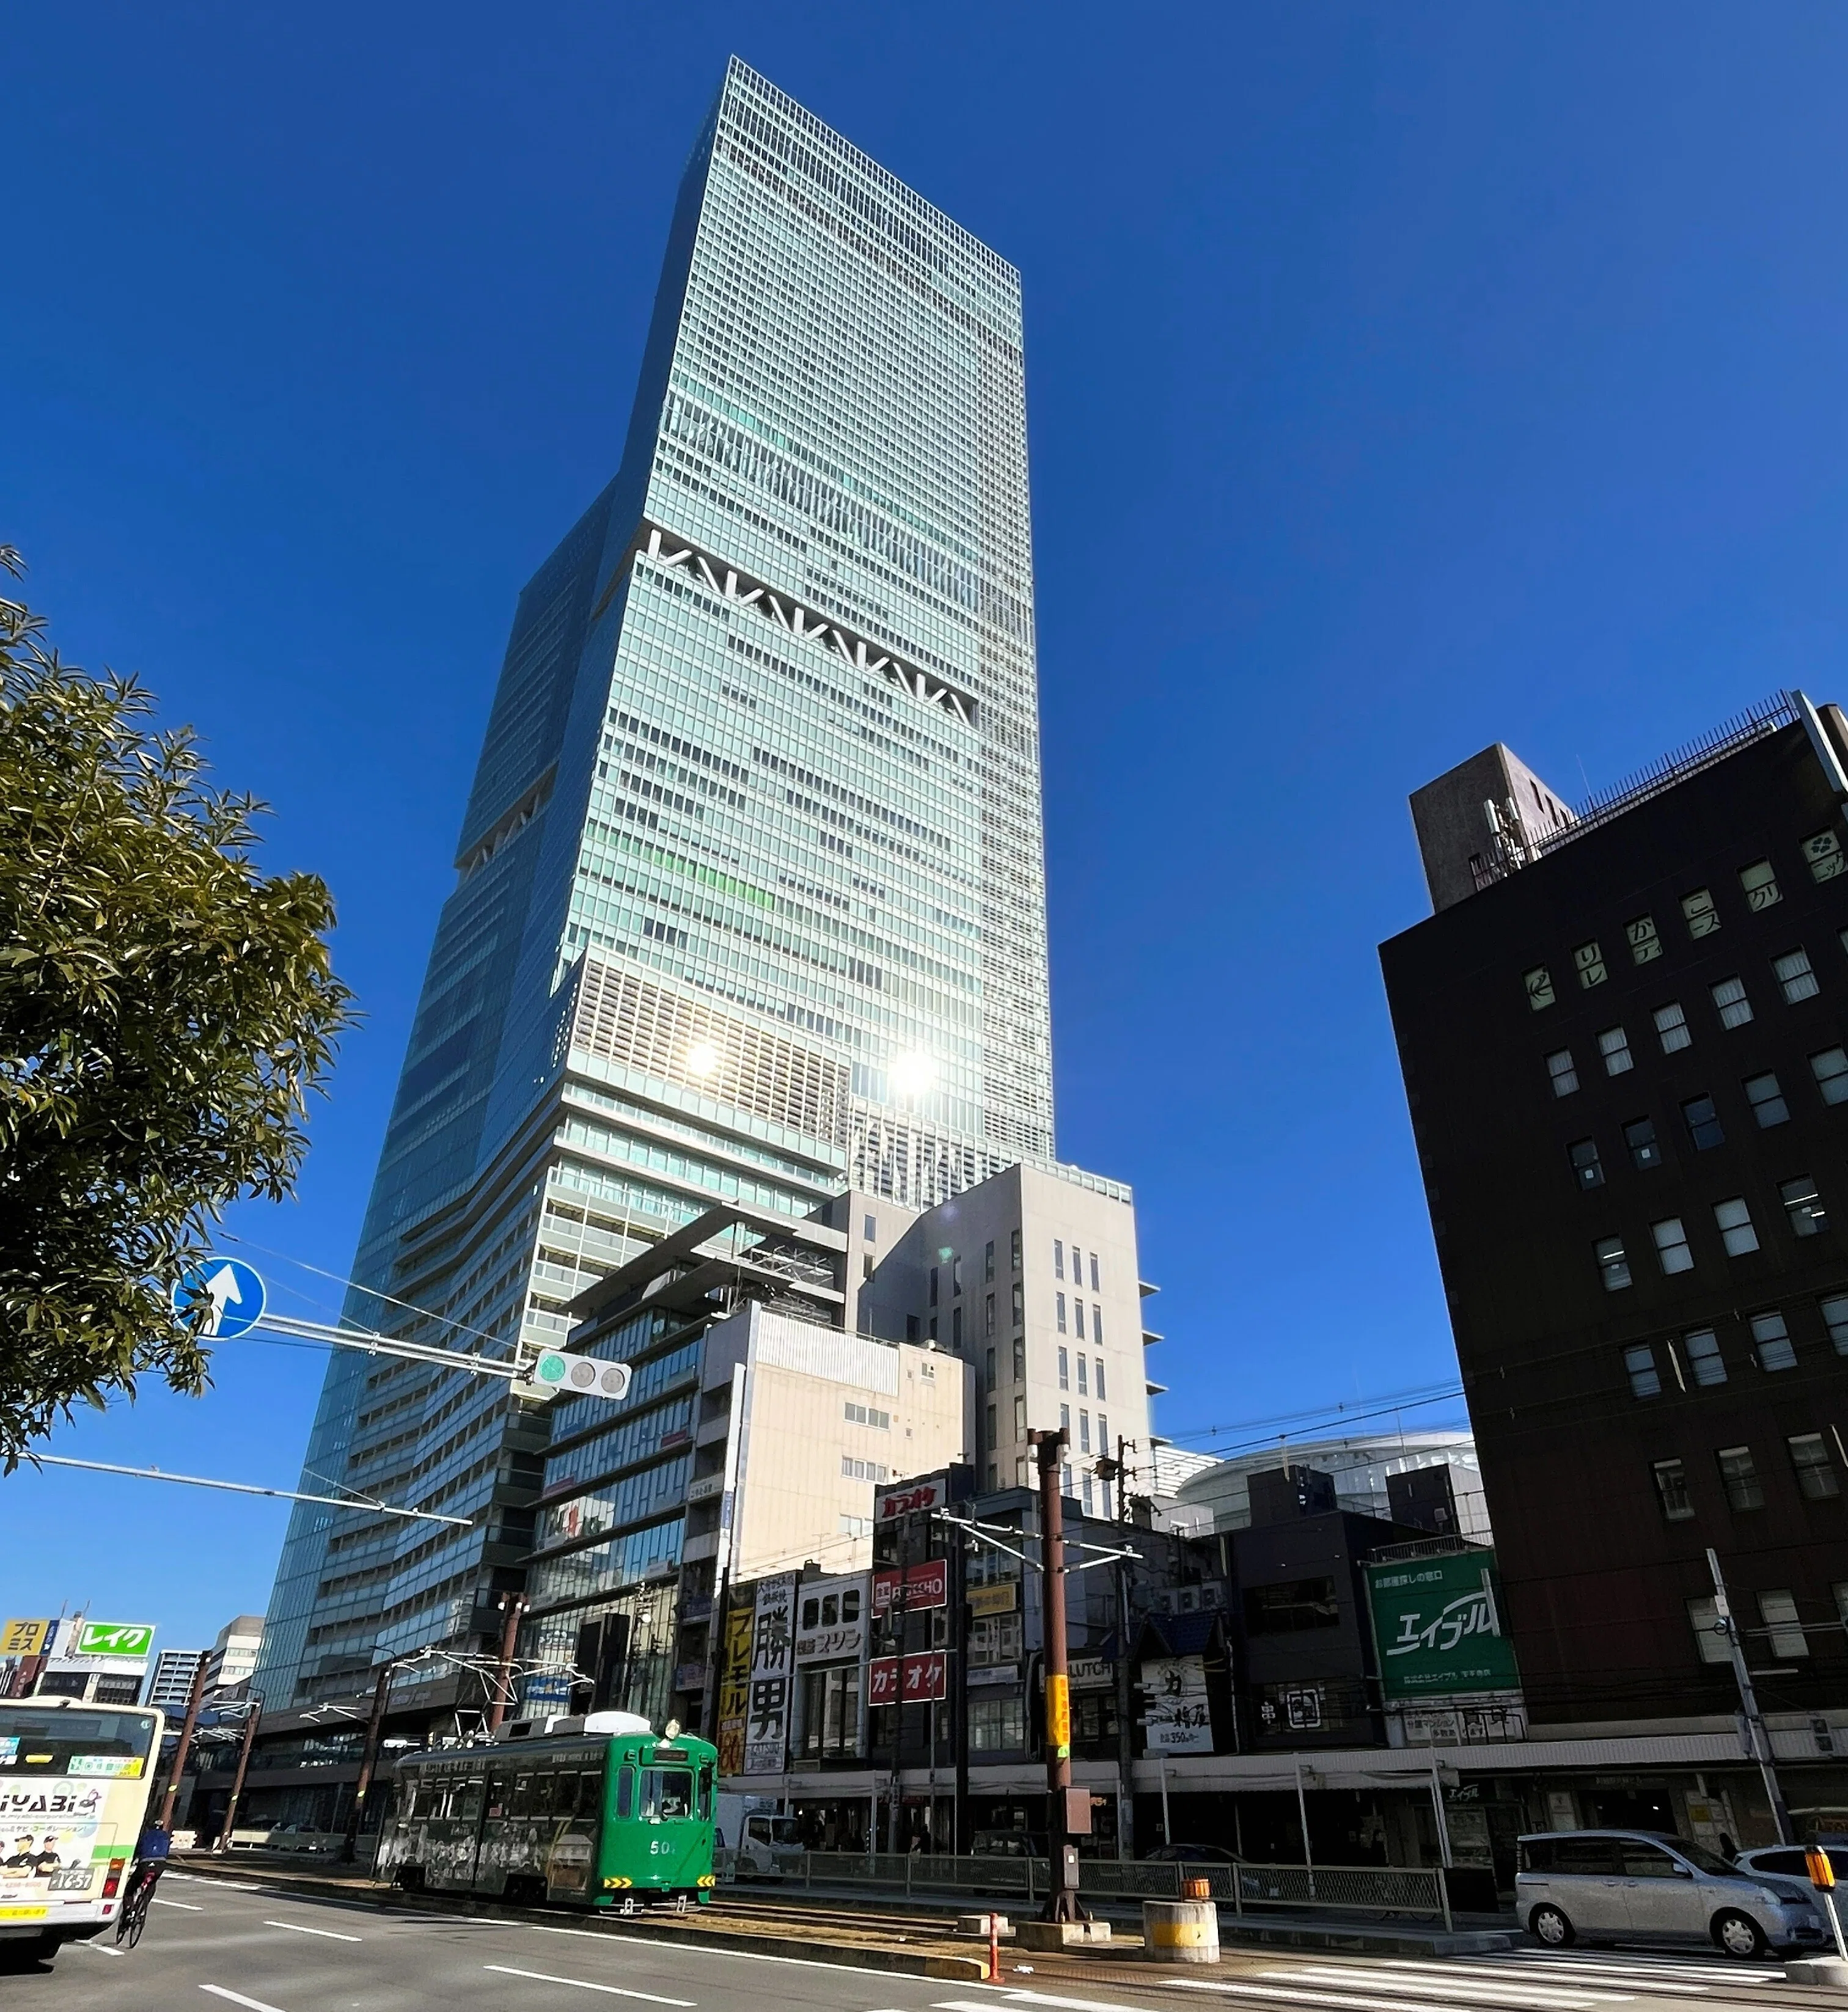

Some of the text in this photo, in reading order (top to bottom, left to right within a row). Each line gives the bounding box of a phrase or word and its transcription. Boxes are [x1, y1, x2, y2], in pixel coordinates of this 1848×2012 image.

[82, 1626, 146, 1648] レイク
[1390, 1594, 1493, 1653] エイブル
